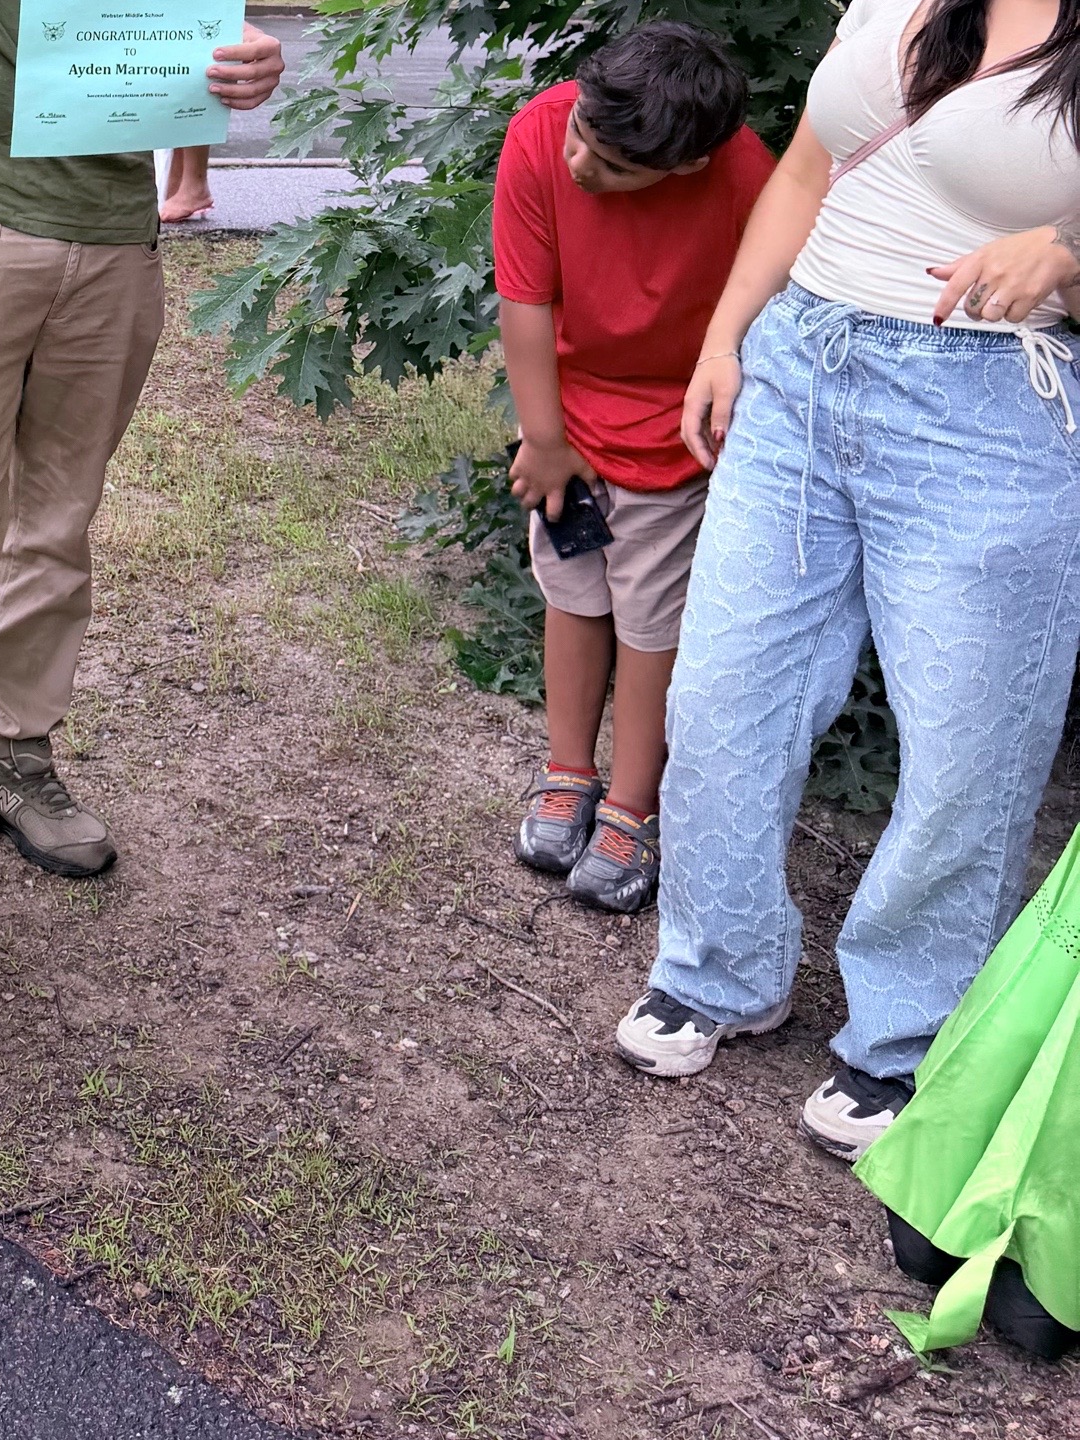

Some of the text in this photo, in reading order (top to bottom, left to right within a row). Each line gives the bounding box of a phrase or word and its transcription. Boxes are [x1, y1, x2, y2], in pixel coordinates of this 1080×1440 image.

[76, 29, 194, 42] CONGRATULATIONS
[124, 47, 137, 57] TO
[69, 63, 190, 78] Ayden Marroquin
